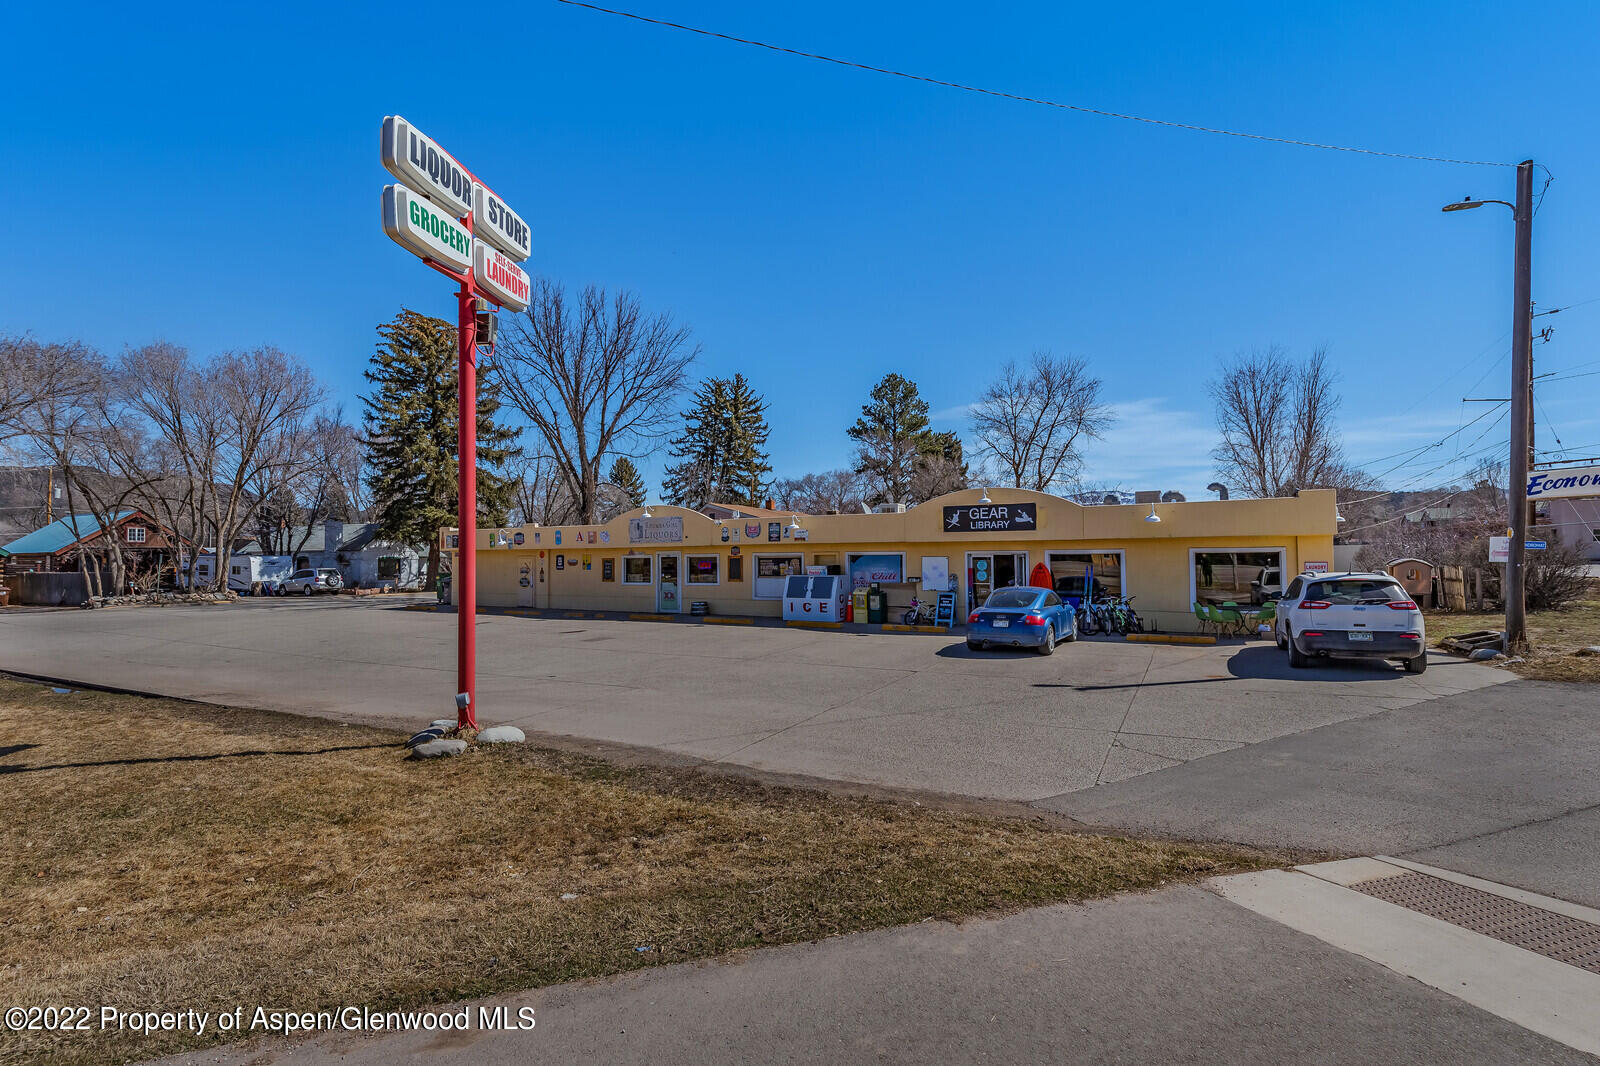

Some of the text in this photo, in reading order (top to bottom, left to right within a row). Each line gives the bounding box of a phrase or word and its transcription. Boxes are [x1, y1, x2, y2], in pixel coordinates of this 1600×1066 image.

[410, 131, 472, 208] LIQUOR
[409, 200, 470, 258] GROCERY
[488, 196, 528, 251] STORE
[486, 258, 529, 302] LAUNDRY
[494, 252, 522, 278] SELF-SERVE
[969, 507, 1008, 520] GEAR
[970, 520, 1010, 530] LIBRARY
[790, 602, 828, 613] ICE
